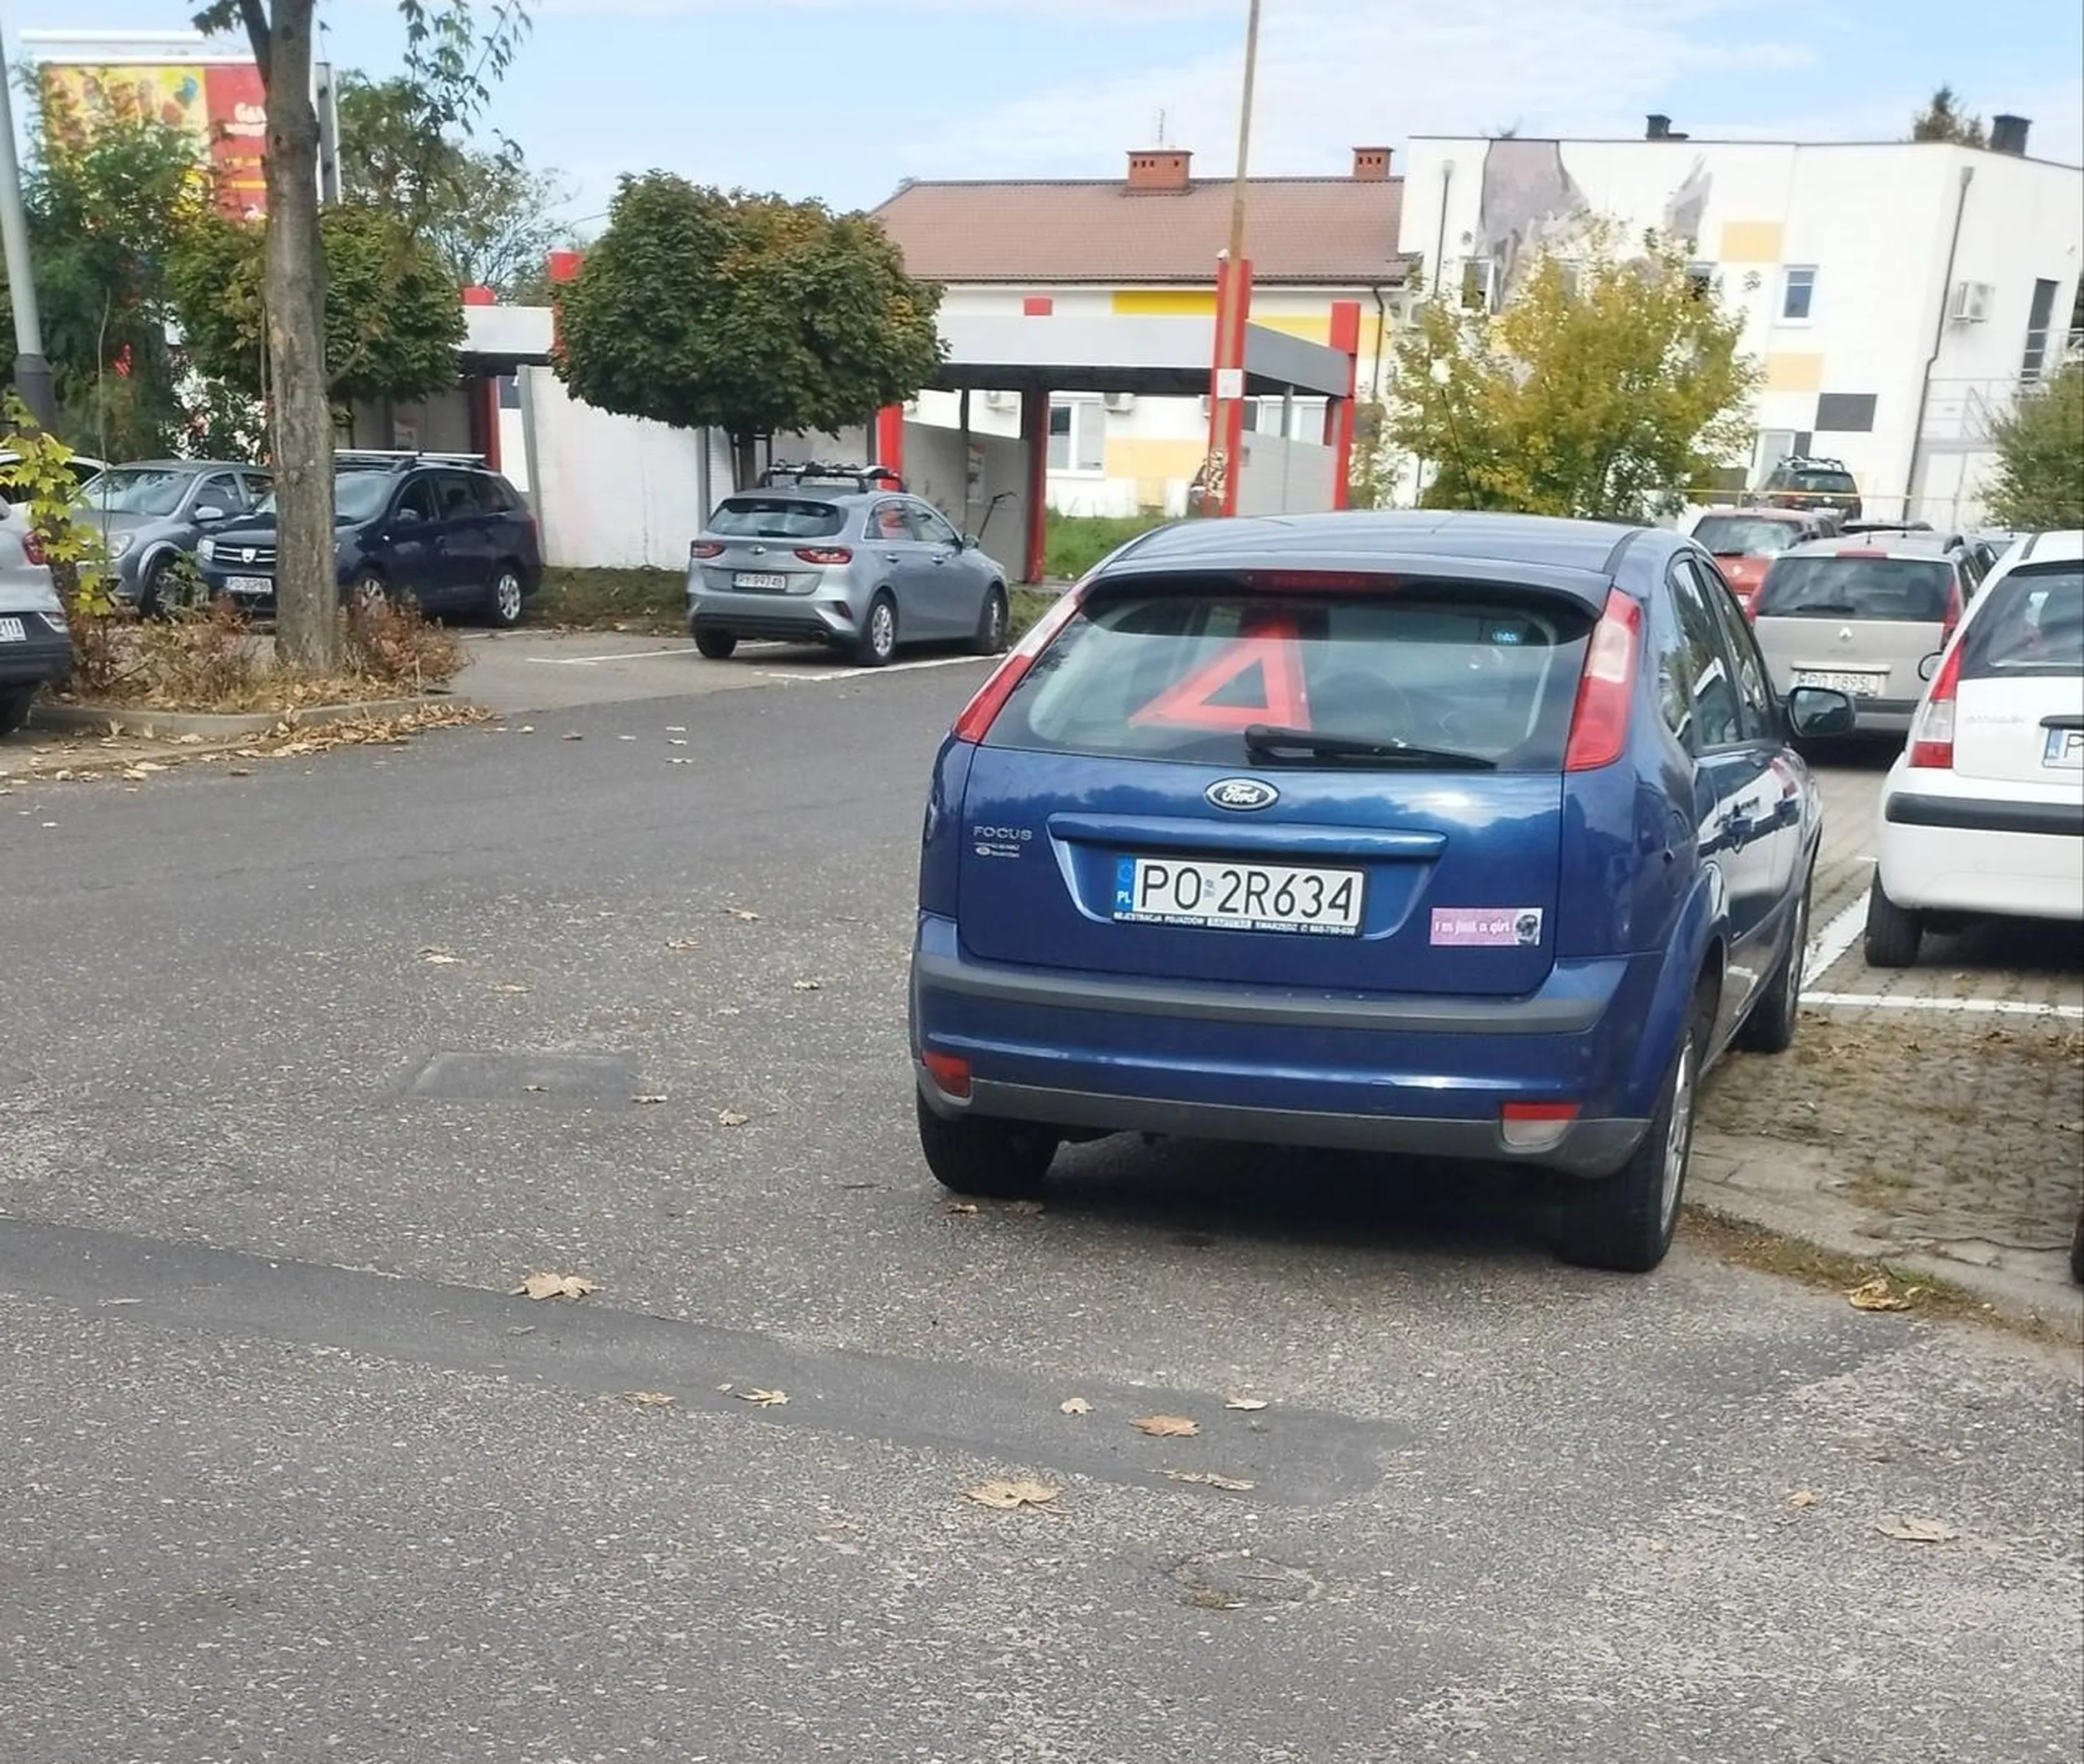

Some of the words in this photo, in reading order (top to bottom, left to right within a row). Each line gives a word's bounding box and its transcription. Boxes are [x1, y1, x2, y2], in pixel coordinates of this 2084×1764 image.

[1221, 784, 1260, 803] Ford
[973, 826, 1033, 840] FOCUS
[1116, 891, 1132, 905] PL
[1141, 864, 1202, 910] PO
[1217, 869, 1353, 920] 2R634
[1479, 922, 1488, 932] a
